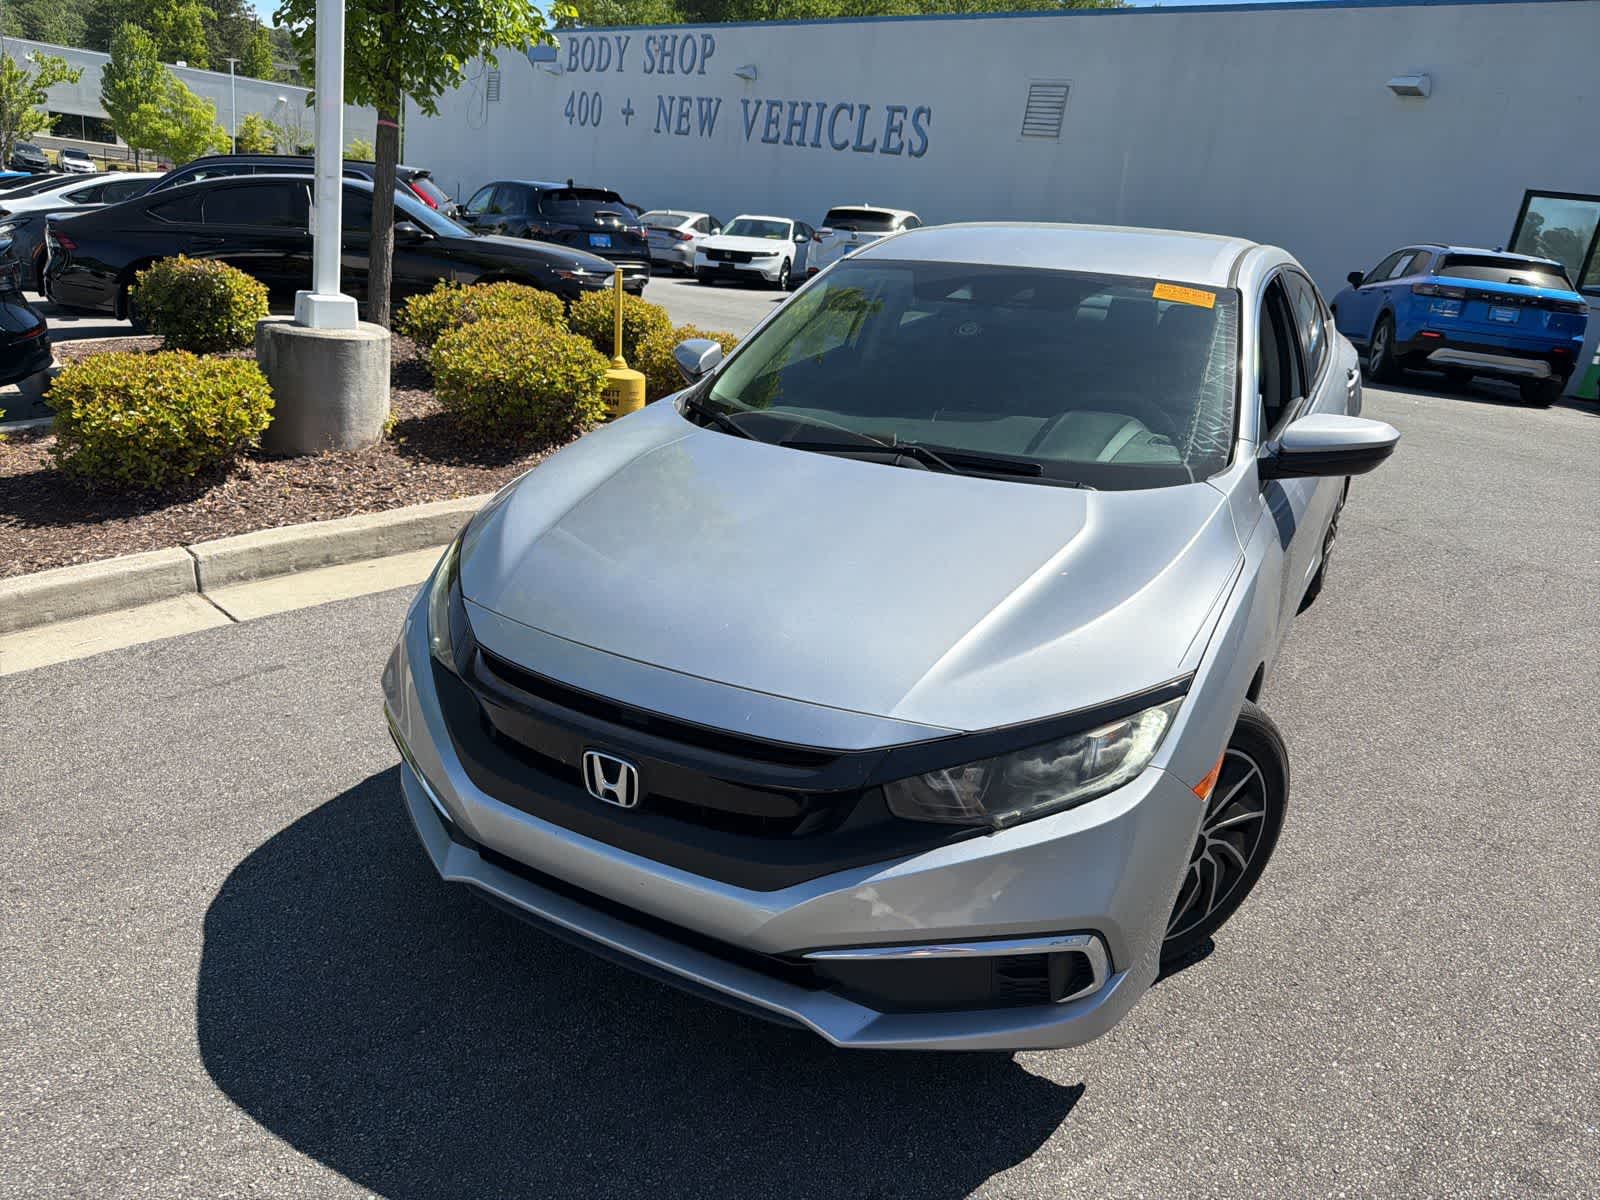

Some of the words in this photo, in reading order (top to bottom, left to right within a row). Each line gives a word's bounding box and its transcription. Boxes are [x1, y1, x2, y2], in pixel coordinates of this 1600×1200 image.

[566, 36, 630, 73] BODY
[643, 33, 716, 75] SHOP
[564, 90, 602, 127] 400
[621, 97, 635, 126] +
[654, 95, 722, 139] NEW
[740, 98, 932, 159] VEHICLES
